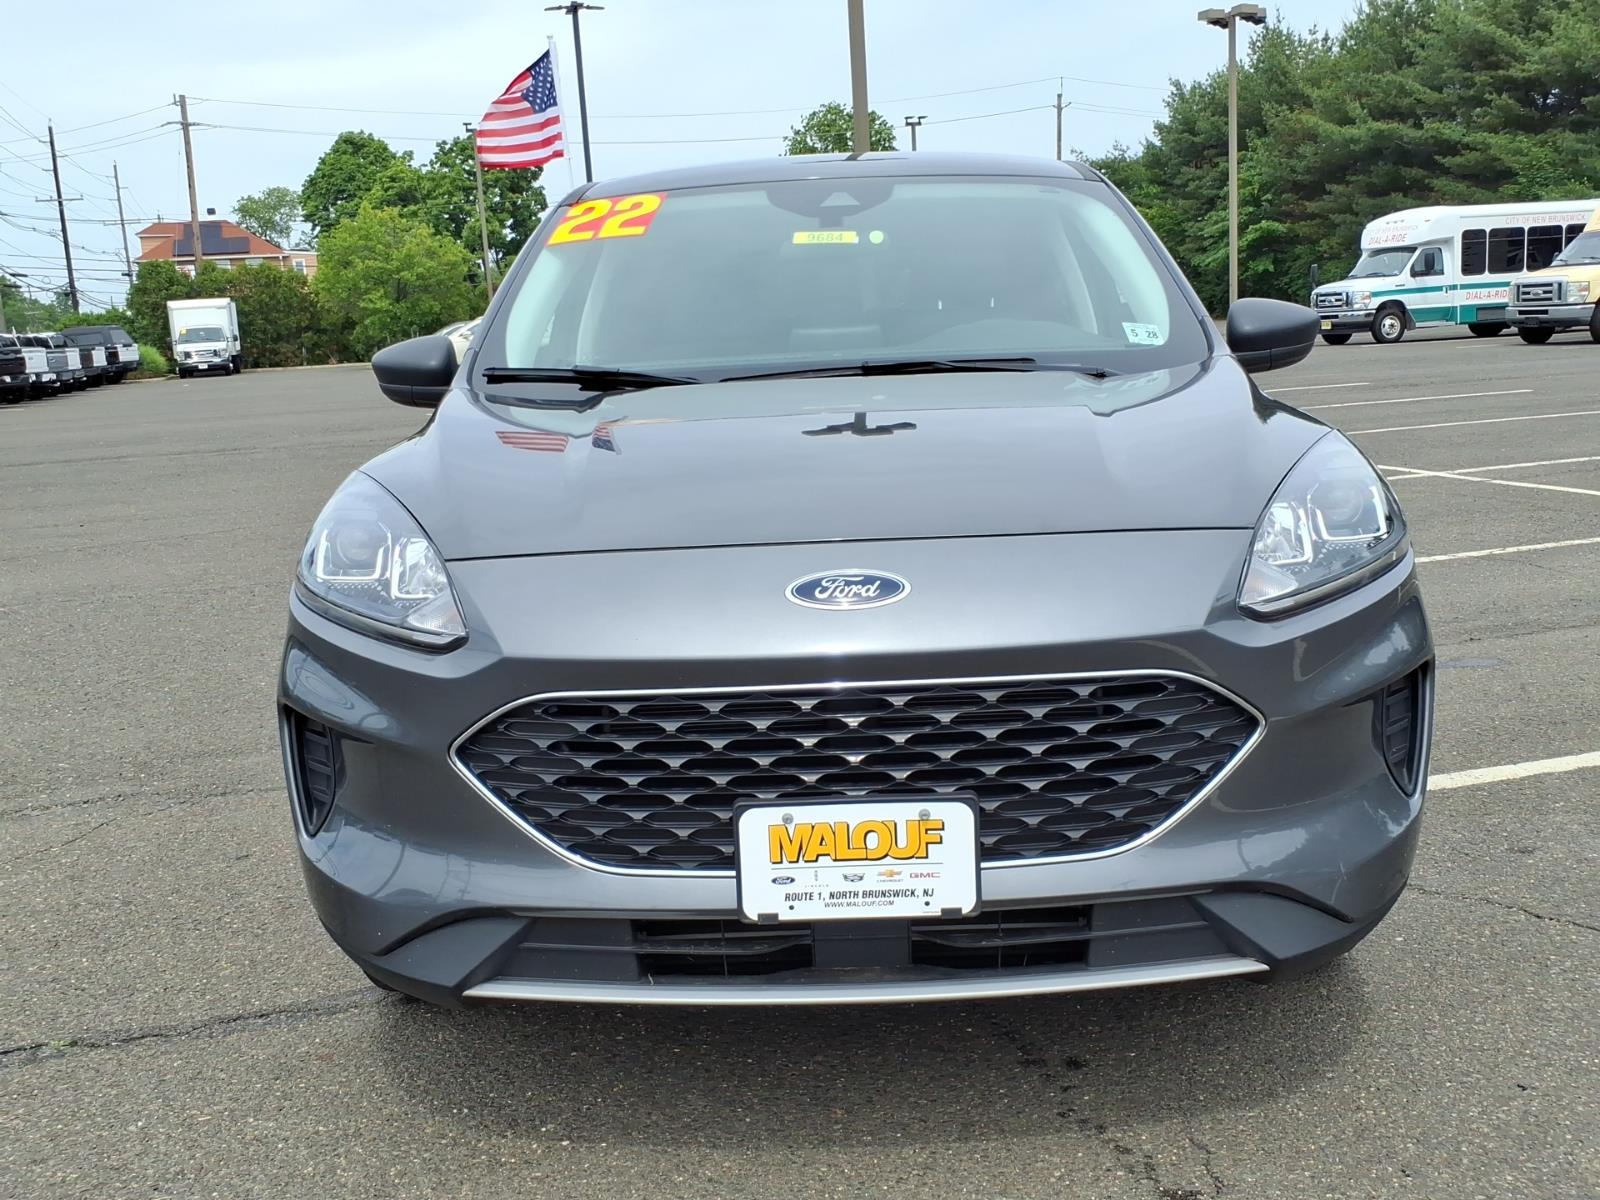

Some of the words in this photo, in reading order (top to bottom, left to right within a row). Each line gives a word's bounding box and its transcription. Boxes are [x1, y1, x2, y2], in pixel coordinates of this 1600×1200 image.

[547, 194, 661, 245] 22
[1505, 215, 1520, 225] CITY
[1521, 215, 1531, 224] OF
[1532, 214, 1547, 224] NEW
[1548, 212, 1585, 223] BRUNSWICK
[807, 232, 843, 242] 9684
[1130, 328, 1138, 338] 5
[1145, 330, 1159, 340] 28
[814, 576, 881, 599] Ford
[767, 819, 945, 865] MALOUF
[784, 891, 814, 902] ROUTE
[818, 892, 826, 902] 1,
[829, 890, 859, 901] NORTH
[861, 888, 919, 899] BRUNSWICK,
[922, 887, 934, 897] NJ
[824, 899, 894, 908] WWW.MALOUF.COM
